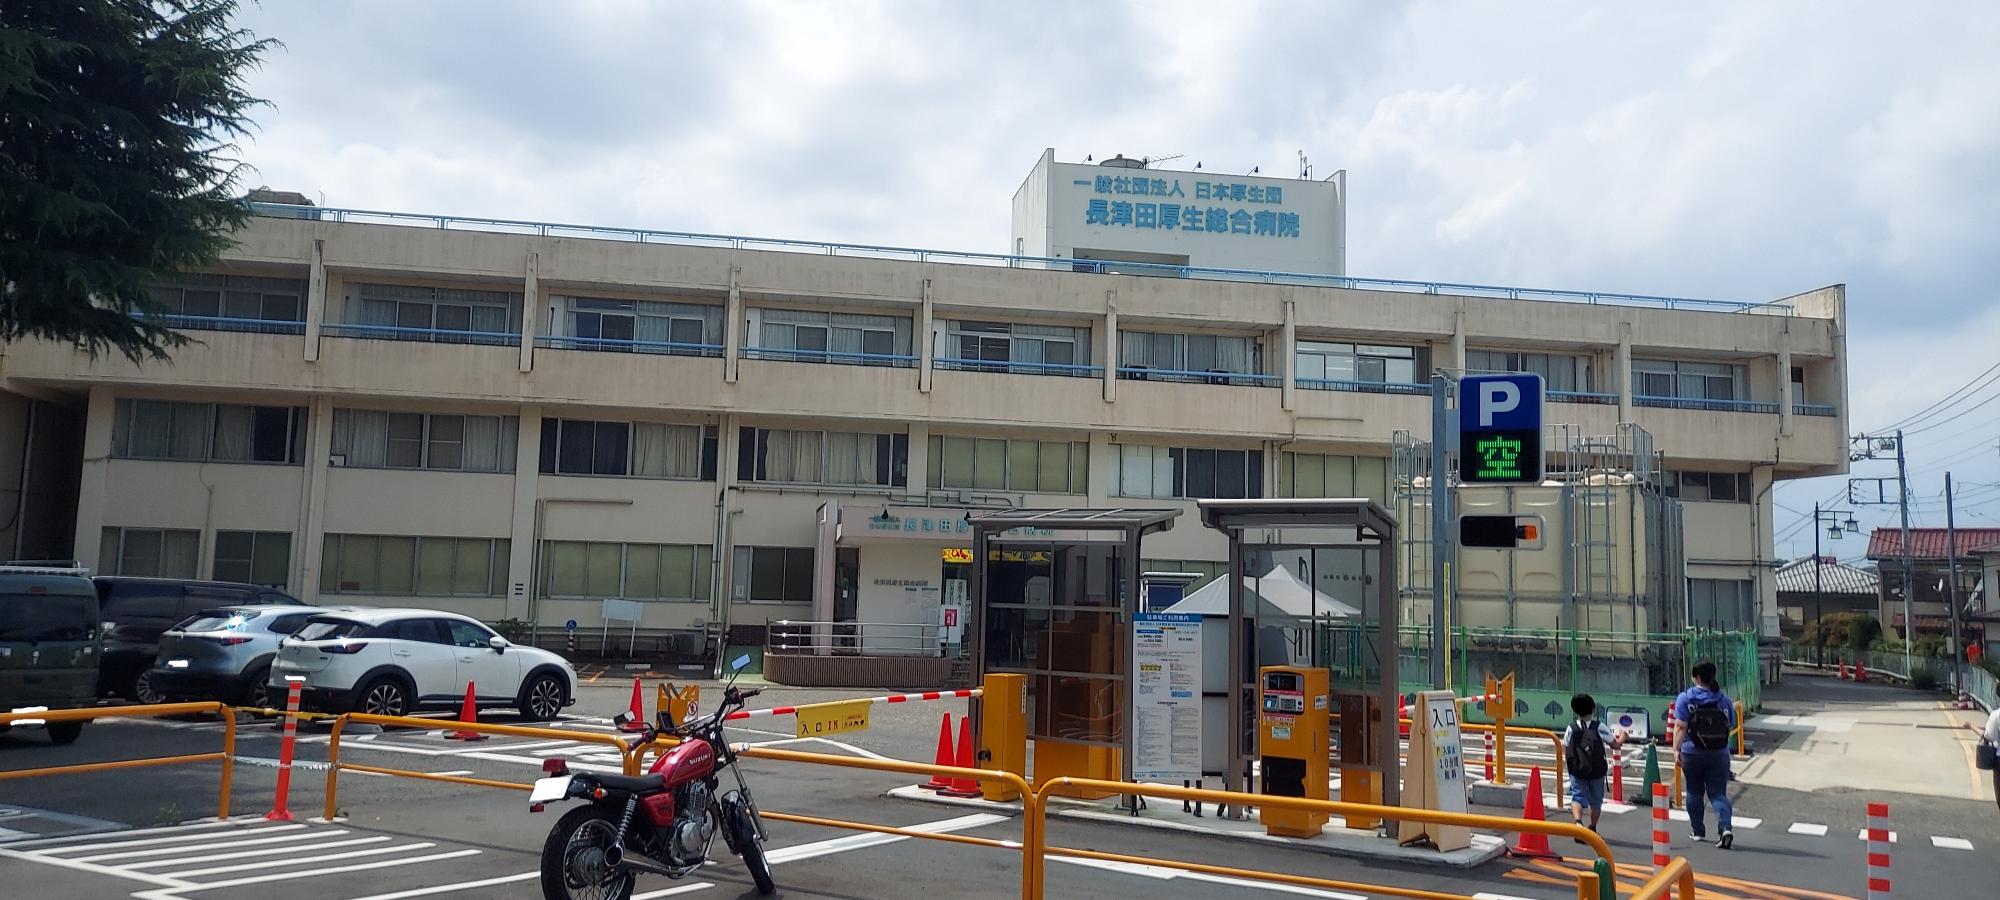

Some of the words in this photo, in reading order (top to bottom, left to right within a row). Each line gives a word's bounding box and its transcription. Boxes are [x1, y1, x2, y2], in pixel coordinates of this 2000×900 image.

[1074, 175, 1185, 198] 一般社団法人
[1195, 181, 1282, 205] 日本厚生団
[1086, 199, 1300, 238] 長津田厚生総合病院
[1479, 381, 1521, 426] P
[1476, 435, 1521, 478] 空
[802, 722, 822, 735] 入口
[828, 719, 839, 731] IN
[1433, 709, 1455, 728] 入口
[689, 753, 711, 765] SUZUKI
